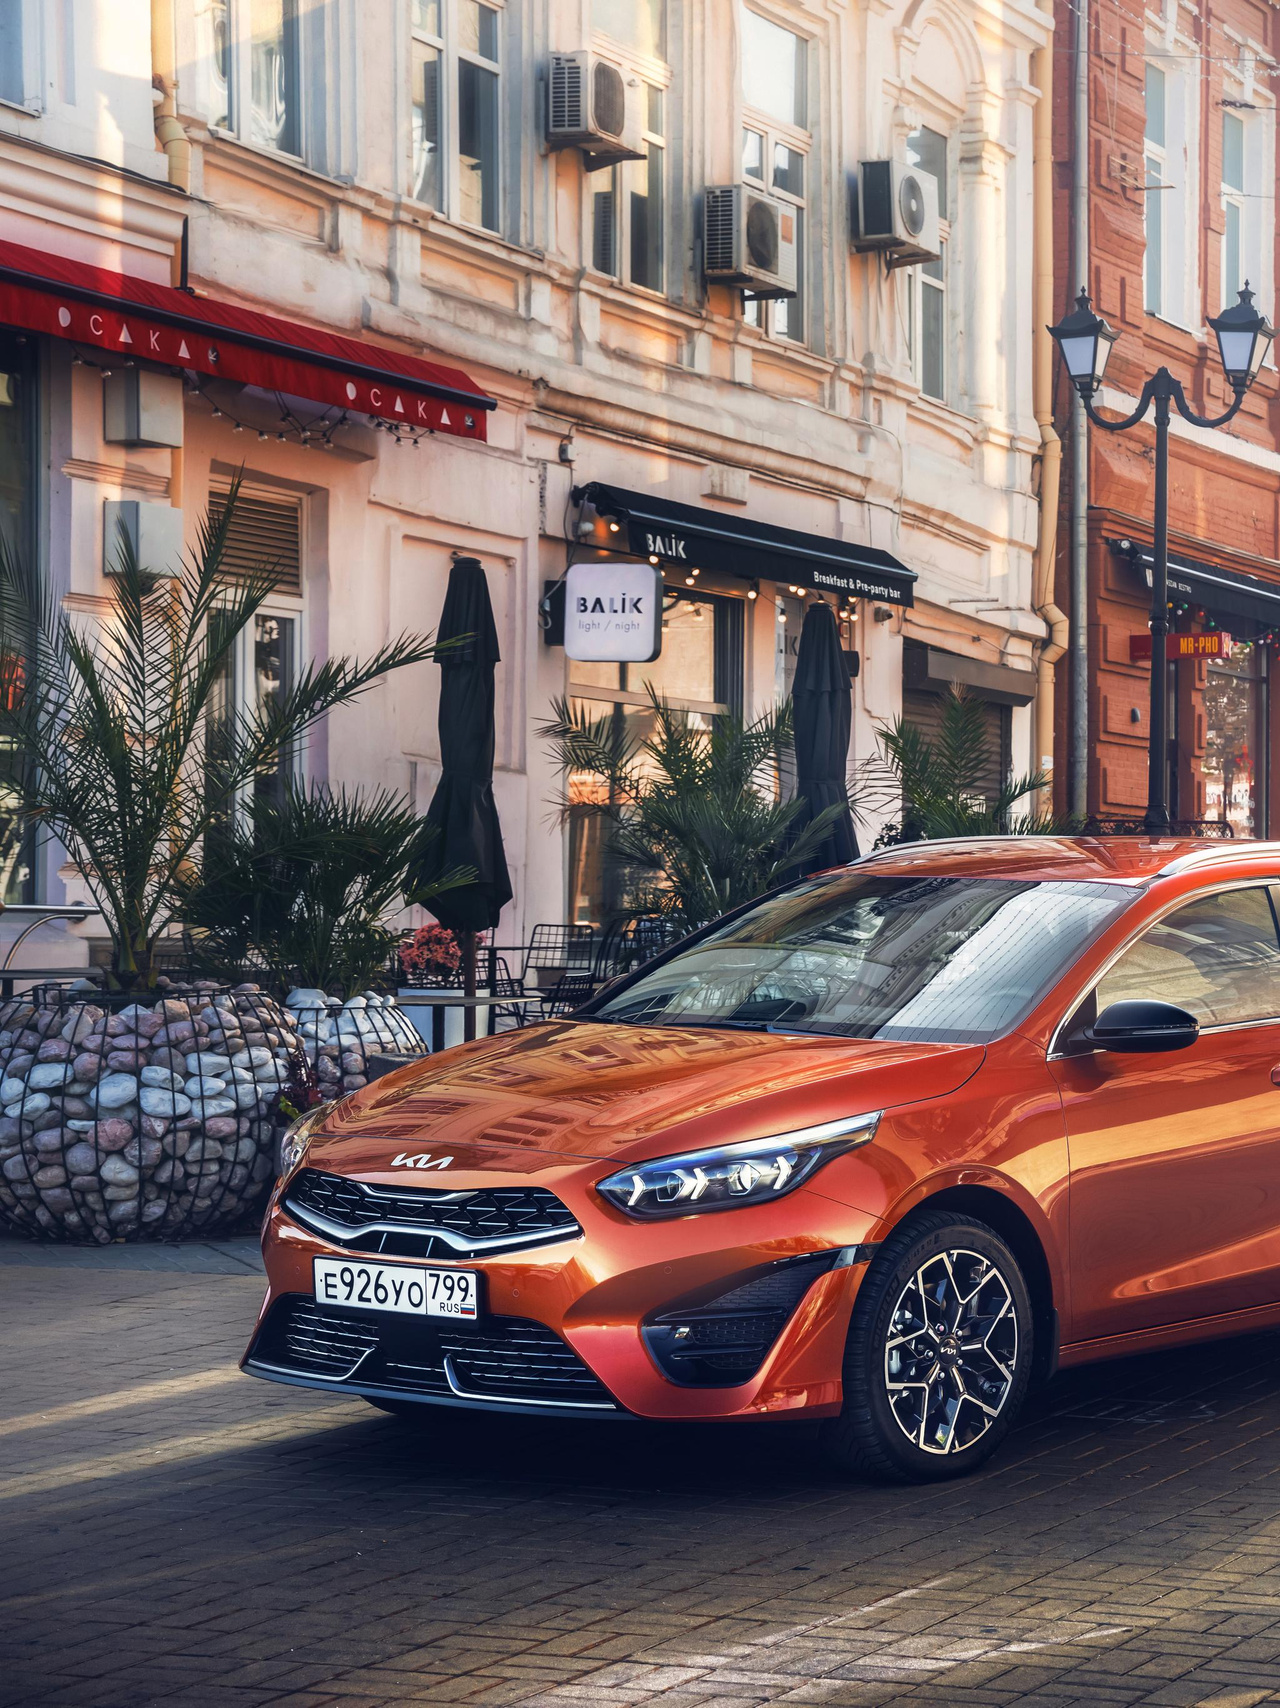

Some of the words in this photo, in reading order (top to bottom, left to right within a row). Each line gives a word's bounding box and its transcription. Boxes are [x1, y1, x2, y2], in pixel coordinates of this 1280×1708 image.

[813, 571, 847, 588] Breakfast
[849, 578, 855, 589] &
[856, 579, 888, 598] Pre-party
[889, 587, 901, 598] bar
[578, 619, 601, 633] light
[615, 620, 640, 633] night
[390, 1152, 455, 1170] KIA
[429, 1273, 470, 1302] 799
[440, 1302, 460, 1313] RUS
